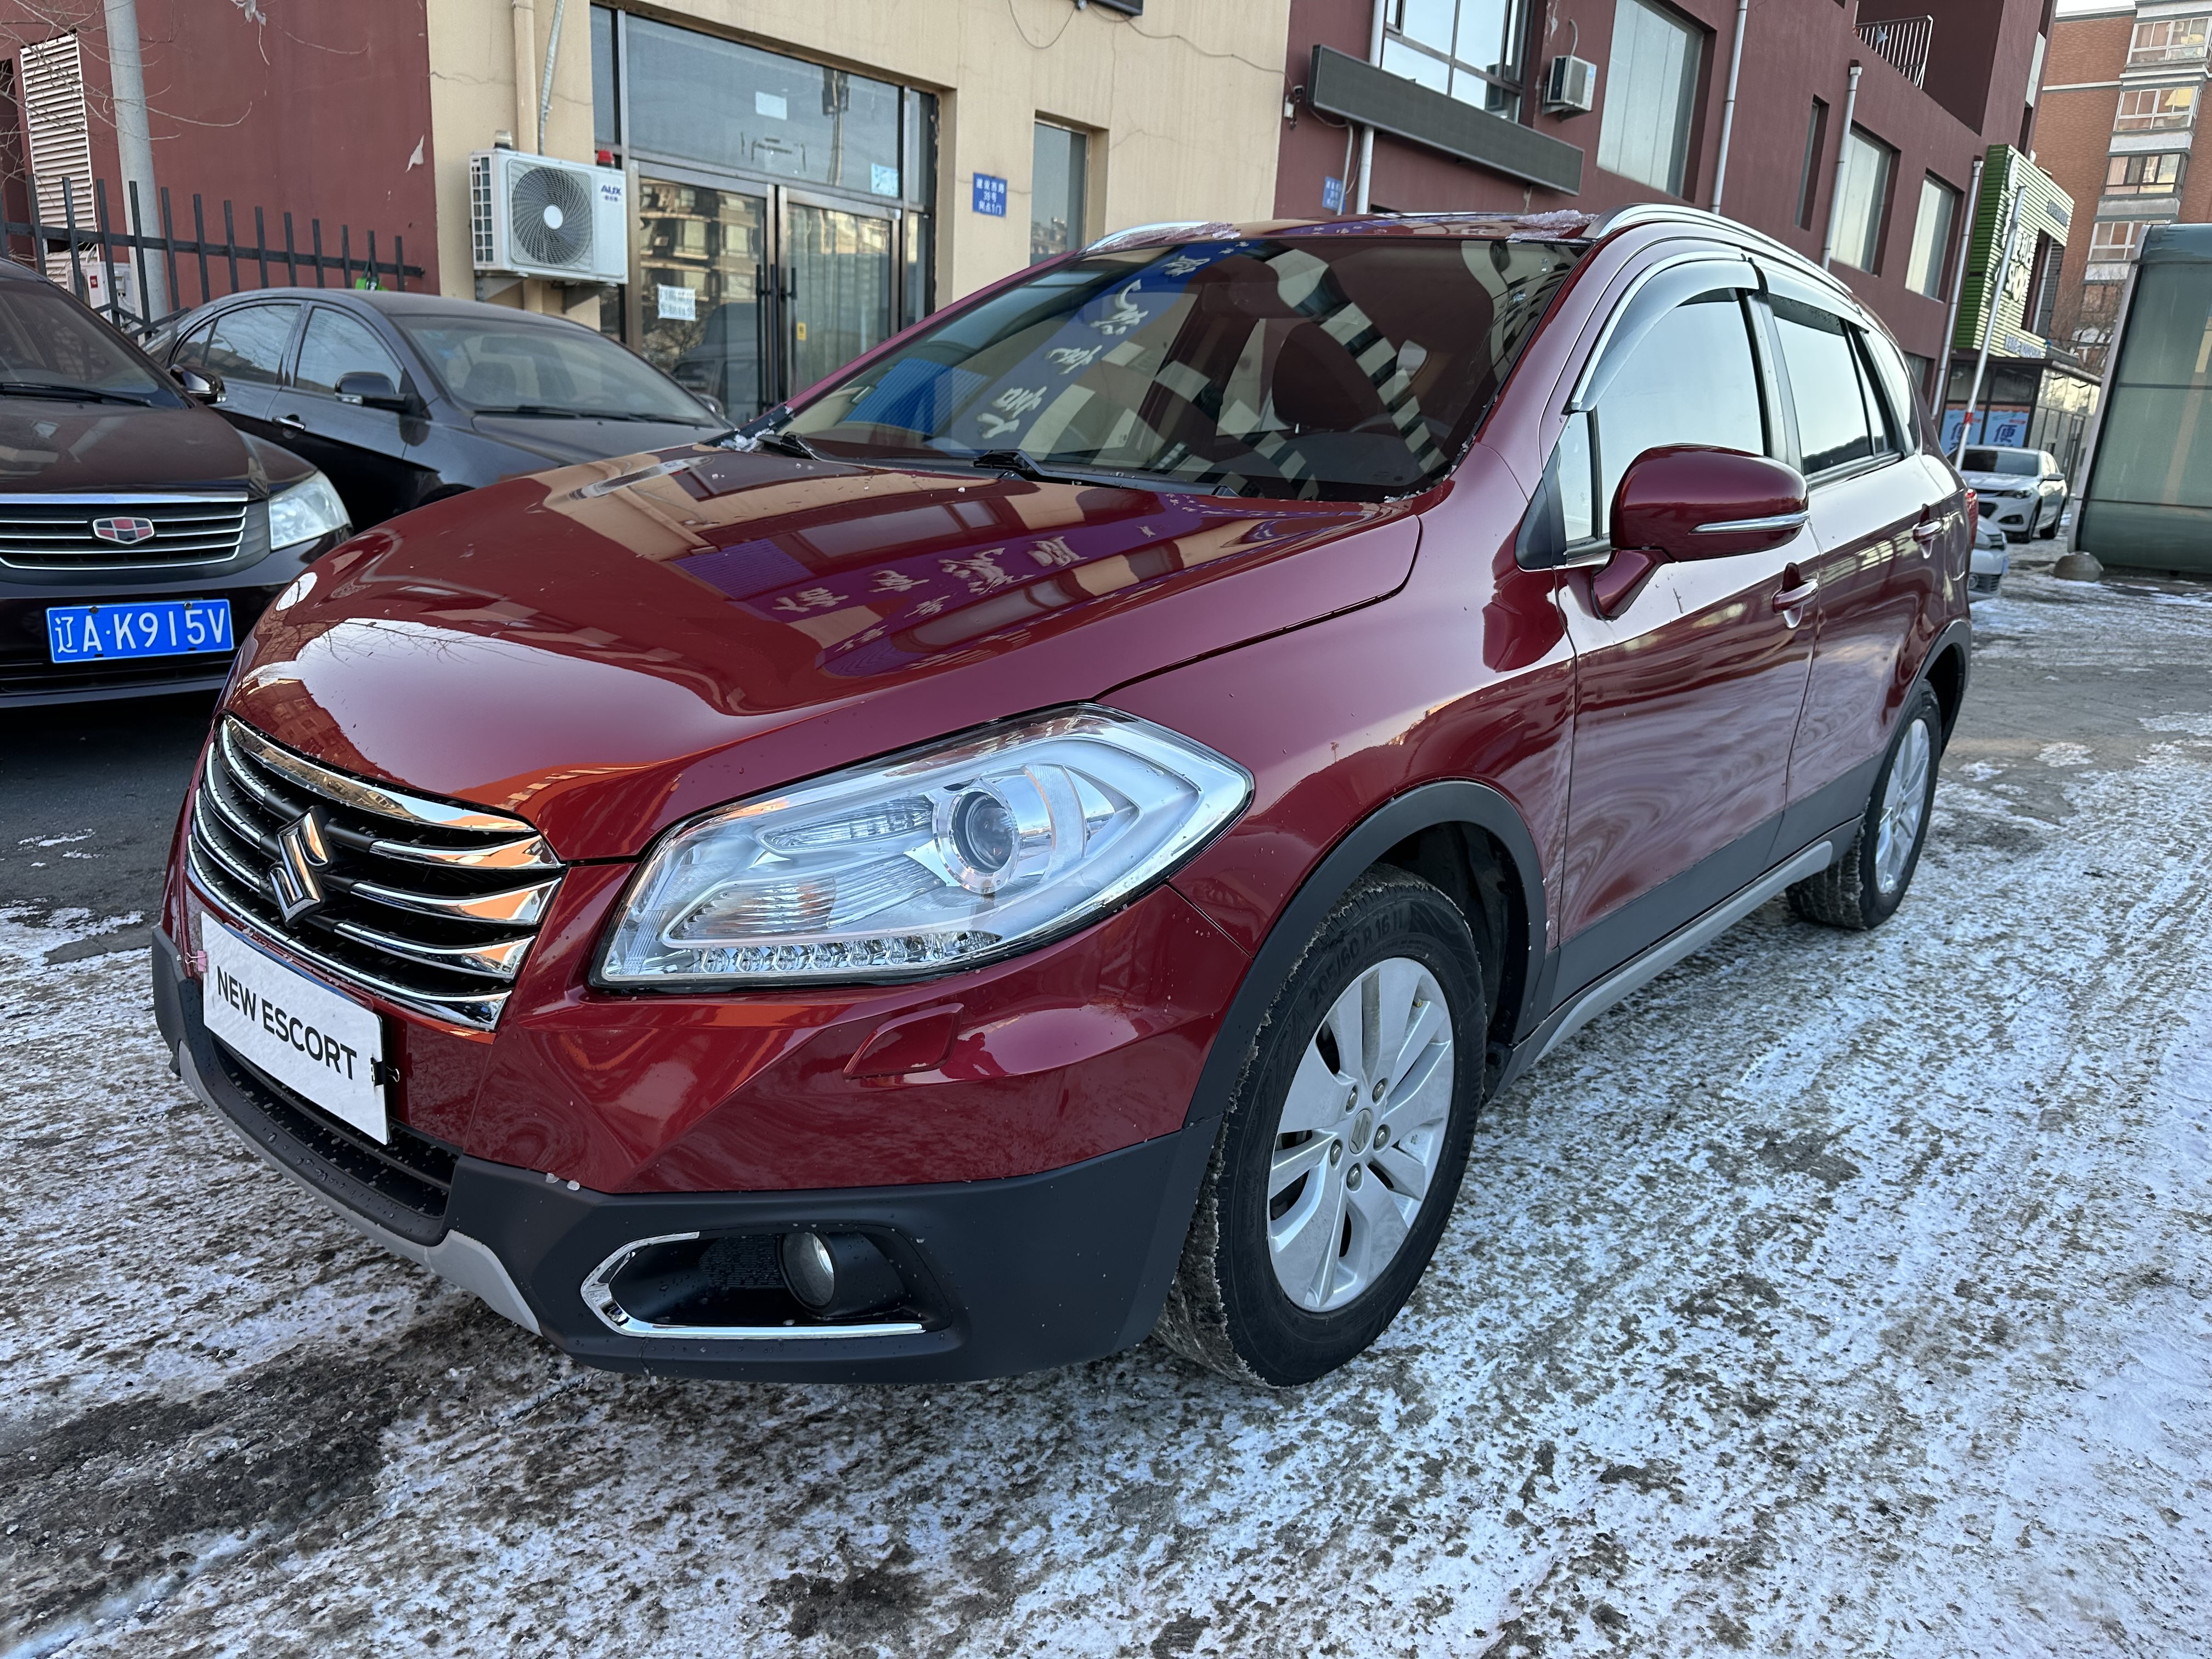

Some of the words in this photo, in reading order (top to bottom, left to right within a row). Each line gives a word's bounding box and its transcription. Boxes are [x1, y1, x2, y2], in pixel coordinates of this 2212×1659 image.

[601, 184, 622, 196] AUX
[1308, 936, 1361, 1011] 205/60
[1363, 924, 1373, 950] R
[1375, 914, 1391, 940] 16
[217, 966, 257, 1022] NEW
[262, 998, 357, 1080] ESCORT
